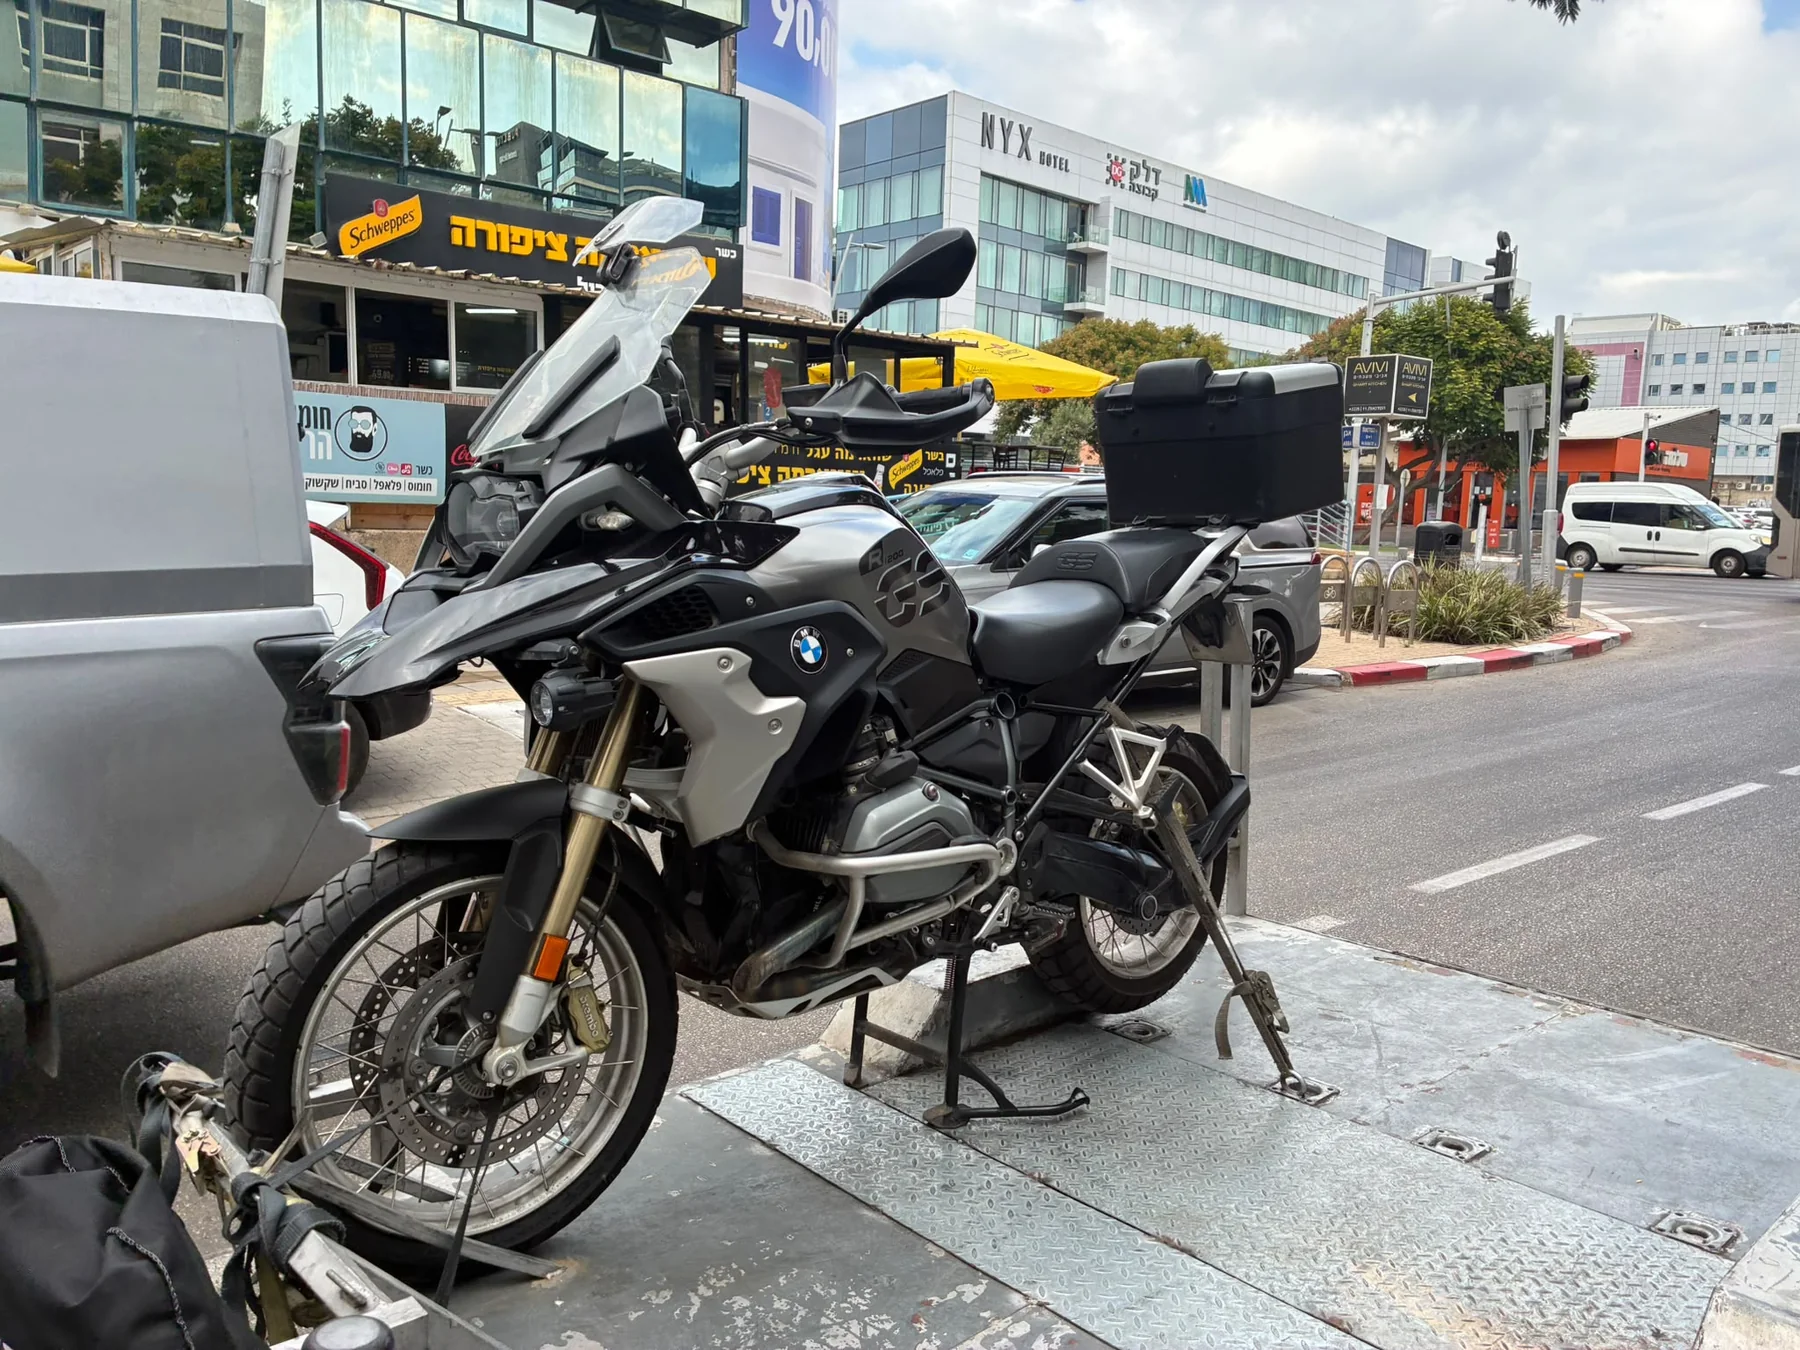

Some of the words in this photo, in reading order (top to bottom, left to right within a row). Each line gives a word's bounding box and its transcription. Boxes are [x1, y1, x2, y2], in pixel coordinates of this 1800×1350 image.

[981, 111, 1033, 161] NYX
[1039, 150, 1070, 173] HOTEL
[1111, 164, 1123, 177] DG
[1130, 159, 1162, 186] דלק
[1129, 181, 1160, 202] קבוצה
[350, 209, 415, 249] Schweppes
[451, 215, 568, 263] ציפורה
[715, 247, 737, 258] כשר
[1353, 361, 1389, 374] AVIVI
[1402, 362, 1428, 377] AVIVI
[925, 451, 944, 462] בשר
[416, 465, 433, 475] כשר
[892, 457, 920, 481] Schweppes
[345, 480, 367, 490] סביח
[373, 479, 402, 490] פלאפל
[408, 482, 432, 491] חומוס
[868, 550, 883, 571] R
[885, 550, 904, 564] 1200
[1056, 552, 1097, 572] GS
[793, 628, 820, 648] BMW
[580, 994, 599, 1038] brembo
